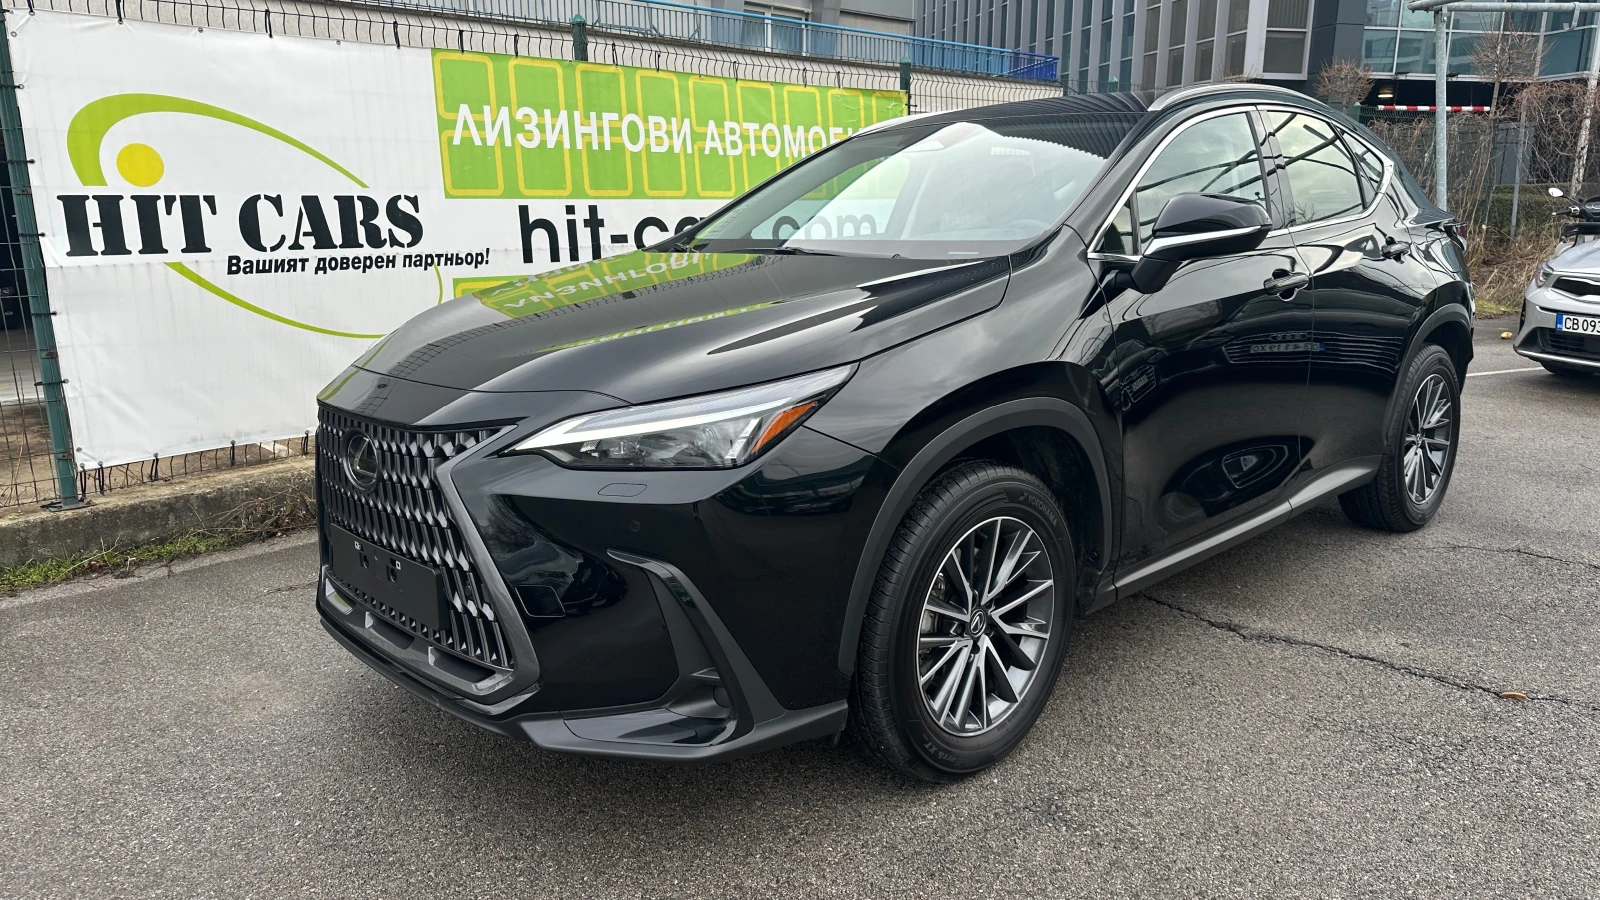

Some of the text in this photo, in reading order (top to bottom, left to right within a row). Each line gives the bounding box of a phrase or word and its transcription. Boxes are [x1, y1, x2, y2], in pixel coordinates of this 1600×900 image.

[452, 103, 865, 158] ЛИЗИНГОВИ АВТОМО
[57, 194, 424, 256] HIT CARS
[227, 248, 490, 275] Вашият доверен партньор!
[1565, 317, 1579, 330] CB
[1028, 494, 1057, 527] YOKOHAMA
